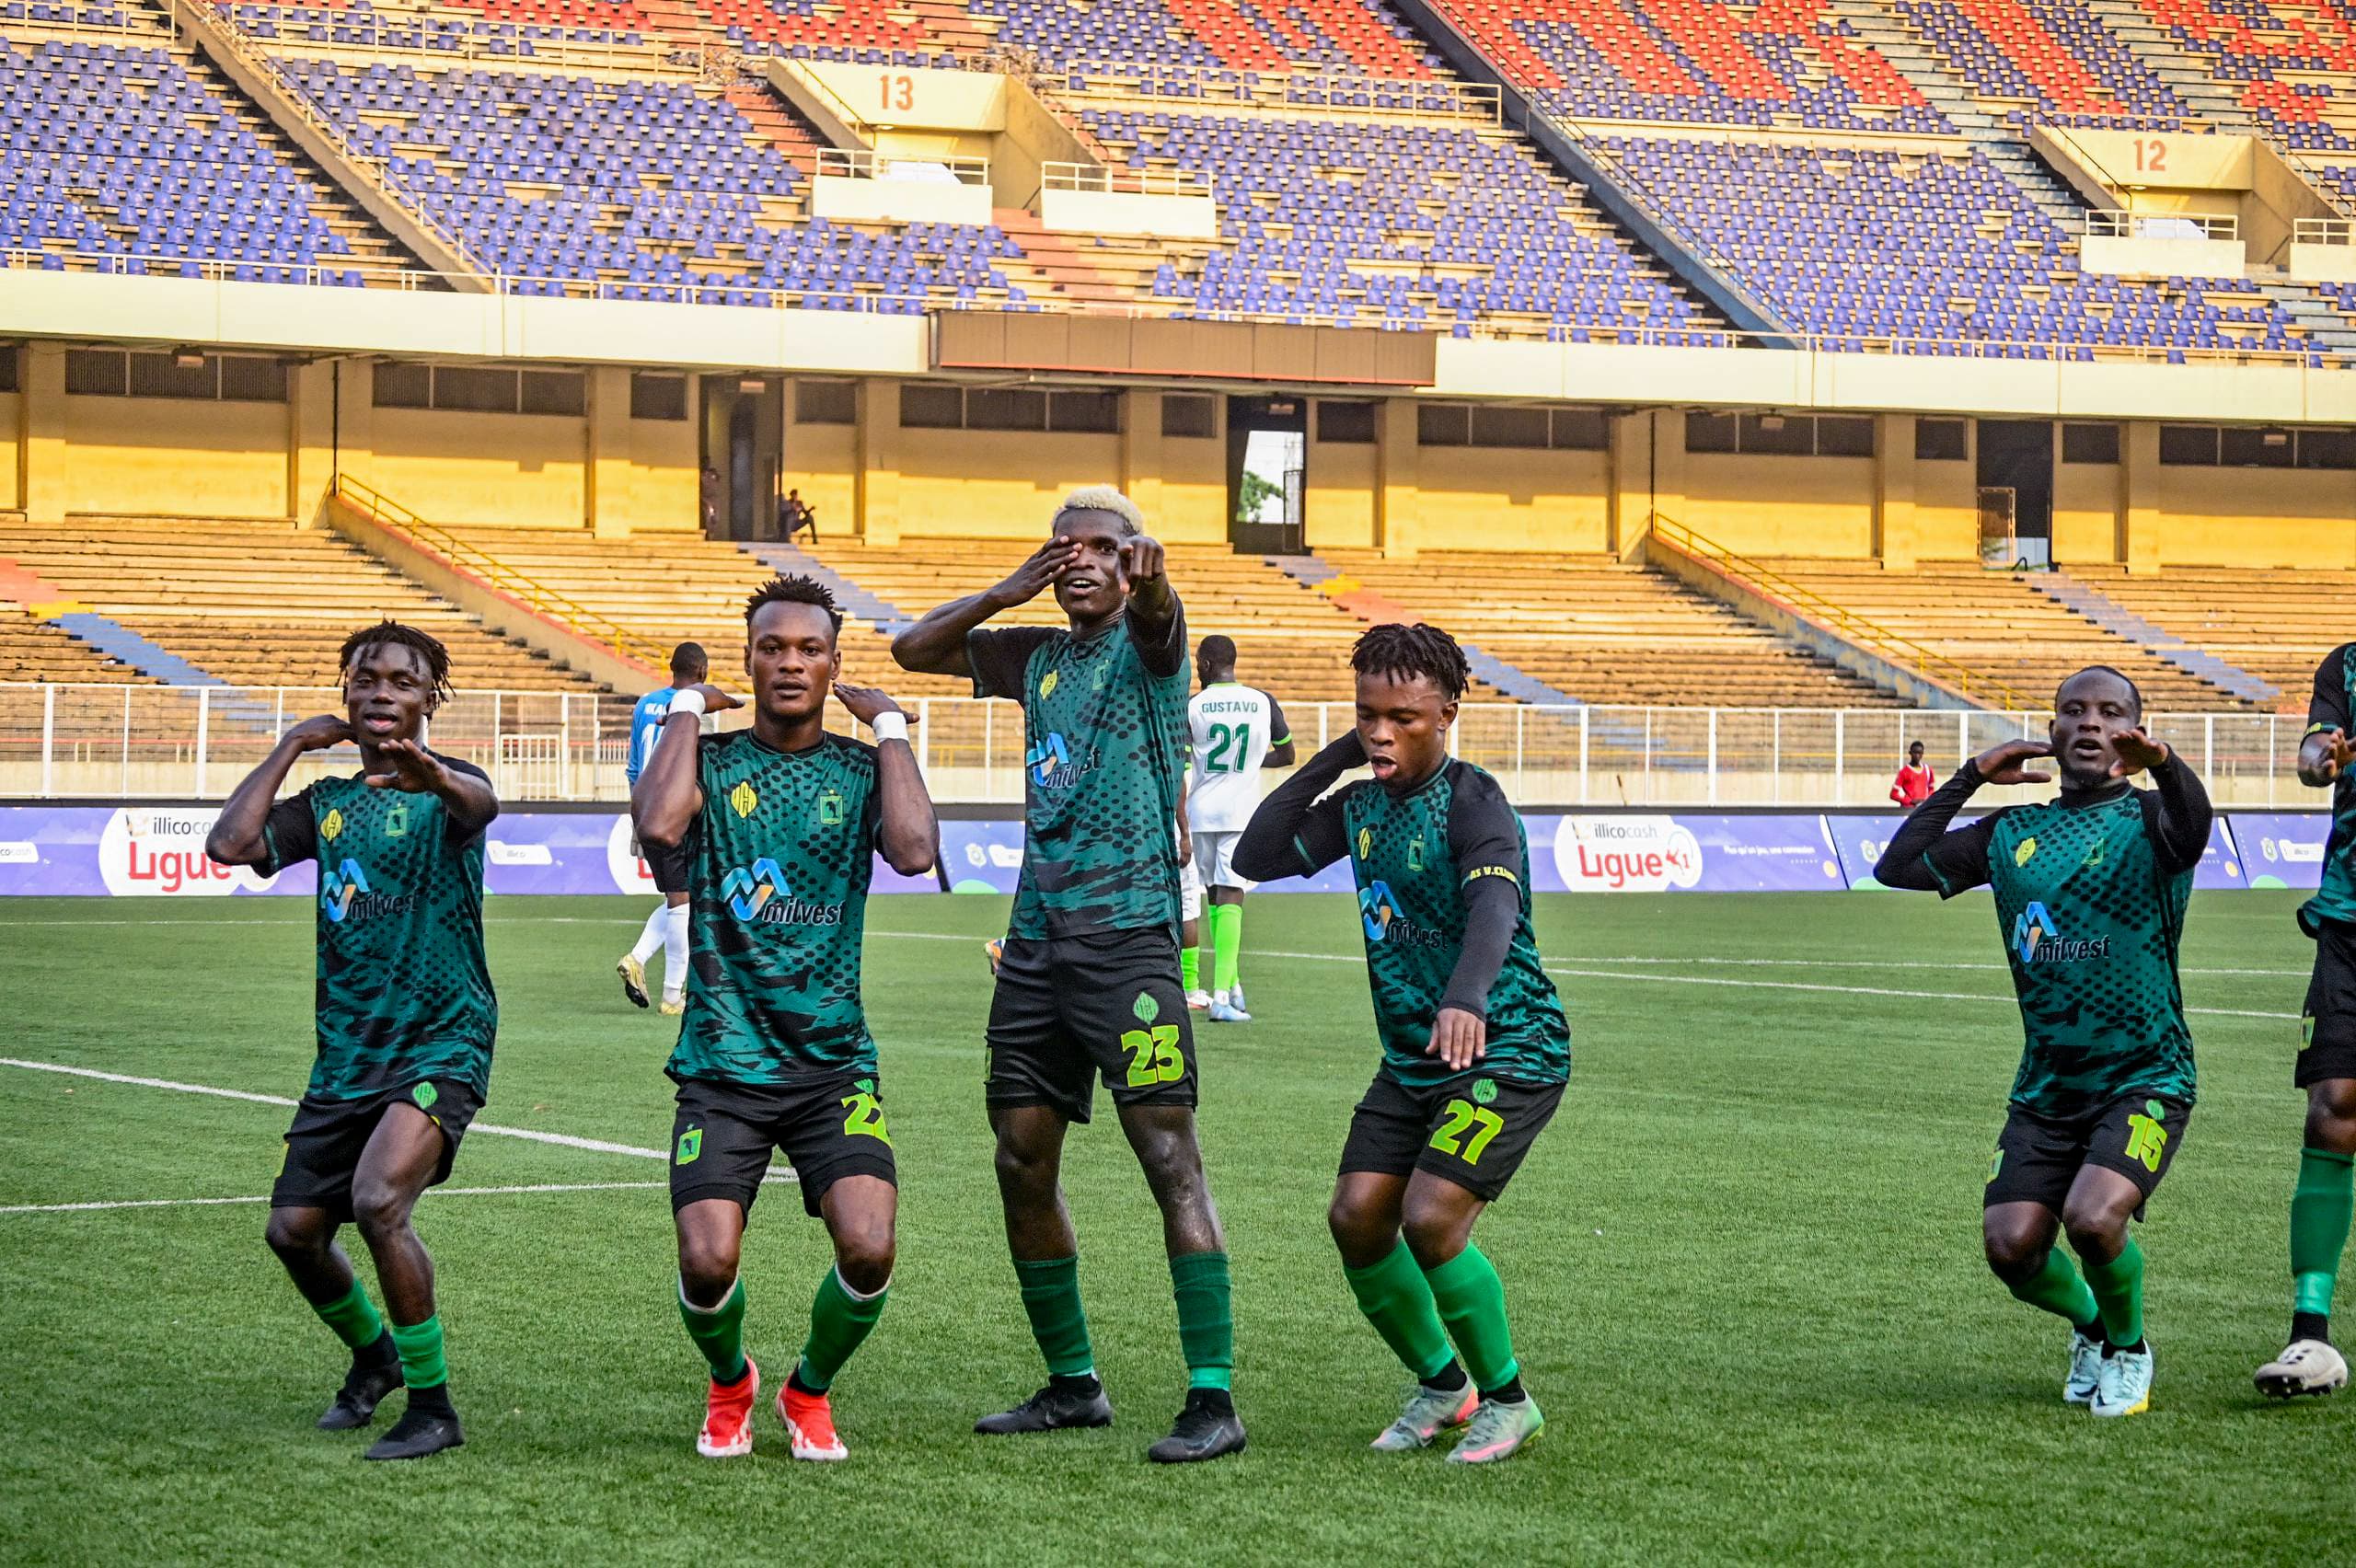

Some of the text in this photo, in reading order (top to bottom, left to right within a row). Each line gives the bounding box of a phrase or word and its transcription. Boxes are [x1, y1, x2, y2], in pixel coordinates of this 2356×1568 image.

[880, 75, 913, 110] 13
[2133, 139, 2165, 171] 12
[1201, 700, 1259, 714] GUSTAVO
[1206, 722, 1251, 774] 21
[1594, 823, 1657, 839] illicocash
[1577, 844, 1664, 888] Ligue
[762, 897, 846, 926] milvest
[2034, 934, 2111, 963] milvest
[1121, 1024, 1184, 1088] 23
[1428, 1099, 1505, 1166] 27
[2125, 1113, 2167, 1172] 15
